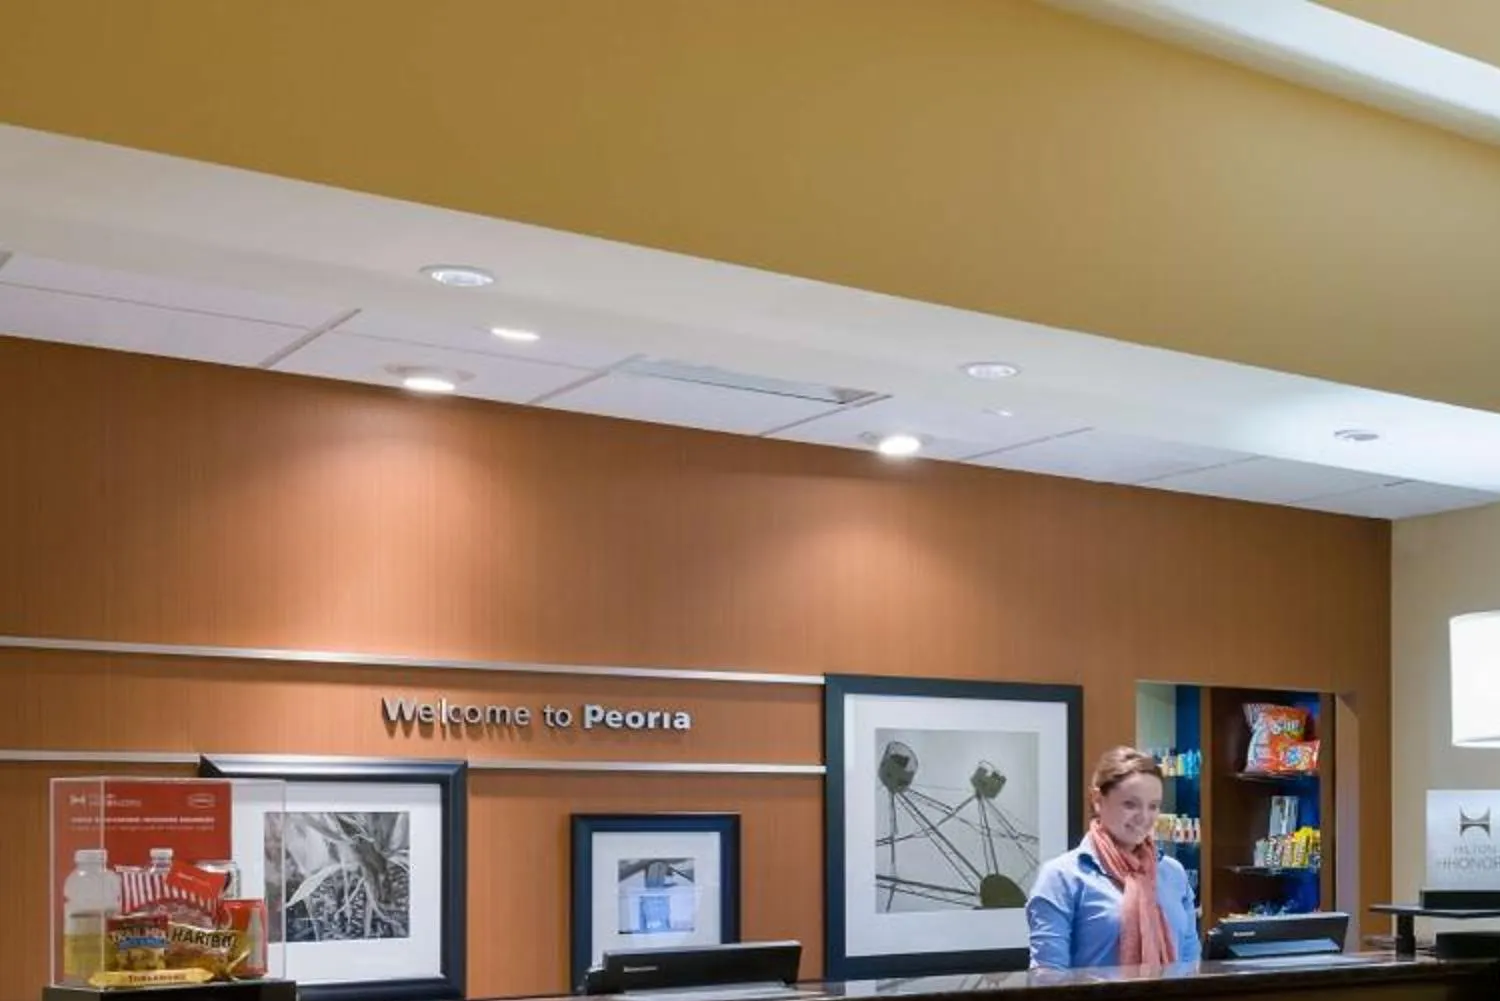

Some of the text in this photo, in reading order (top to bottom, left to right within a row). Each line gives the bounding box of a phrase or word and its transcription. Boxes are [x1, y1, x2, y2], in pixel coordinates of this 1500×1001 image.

[382, 697, 691, 731] Welcome to Peoria
